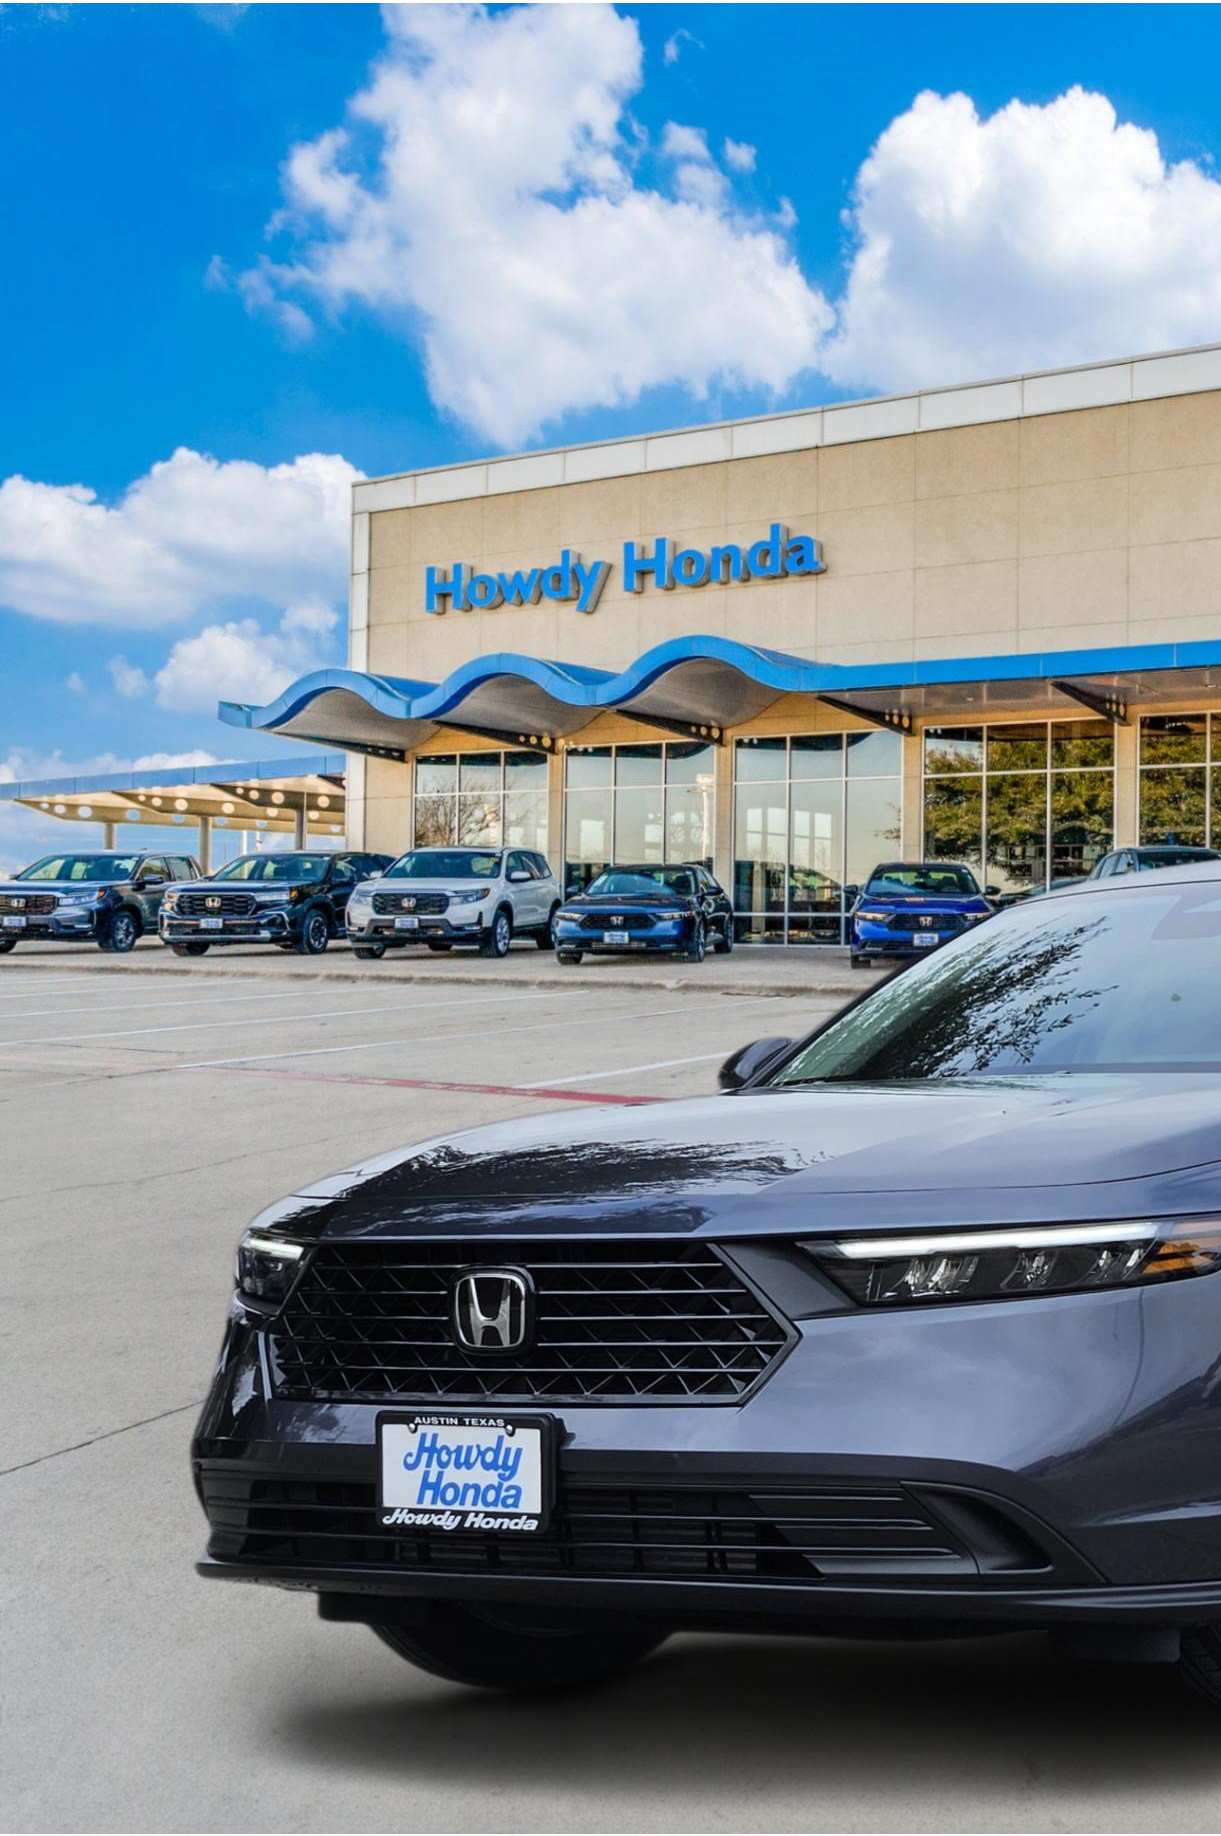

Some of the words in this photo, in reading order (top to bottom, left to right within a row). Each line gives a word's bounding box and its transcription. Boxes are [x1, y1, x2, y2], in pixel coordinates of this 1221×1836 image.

[425, 548, 611, 615] Howdy
[622, 522, 825, 594] Honda
[413, 1416, 459, 1426] AUSTIN
[463, 1417, 505, 1427] TEXAS
[403, 1432, 523, 1482] Howdy
[416, 1470, 523, 1509] Honda
[382, 1508, 462, 1530] Howdy
[463, 1513, 538, 1531] Honda
